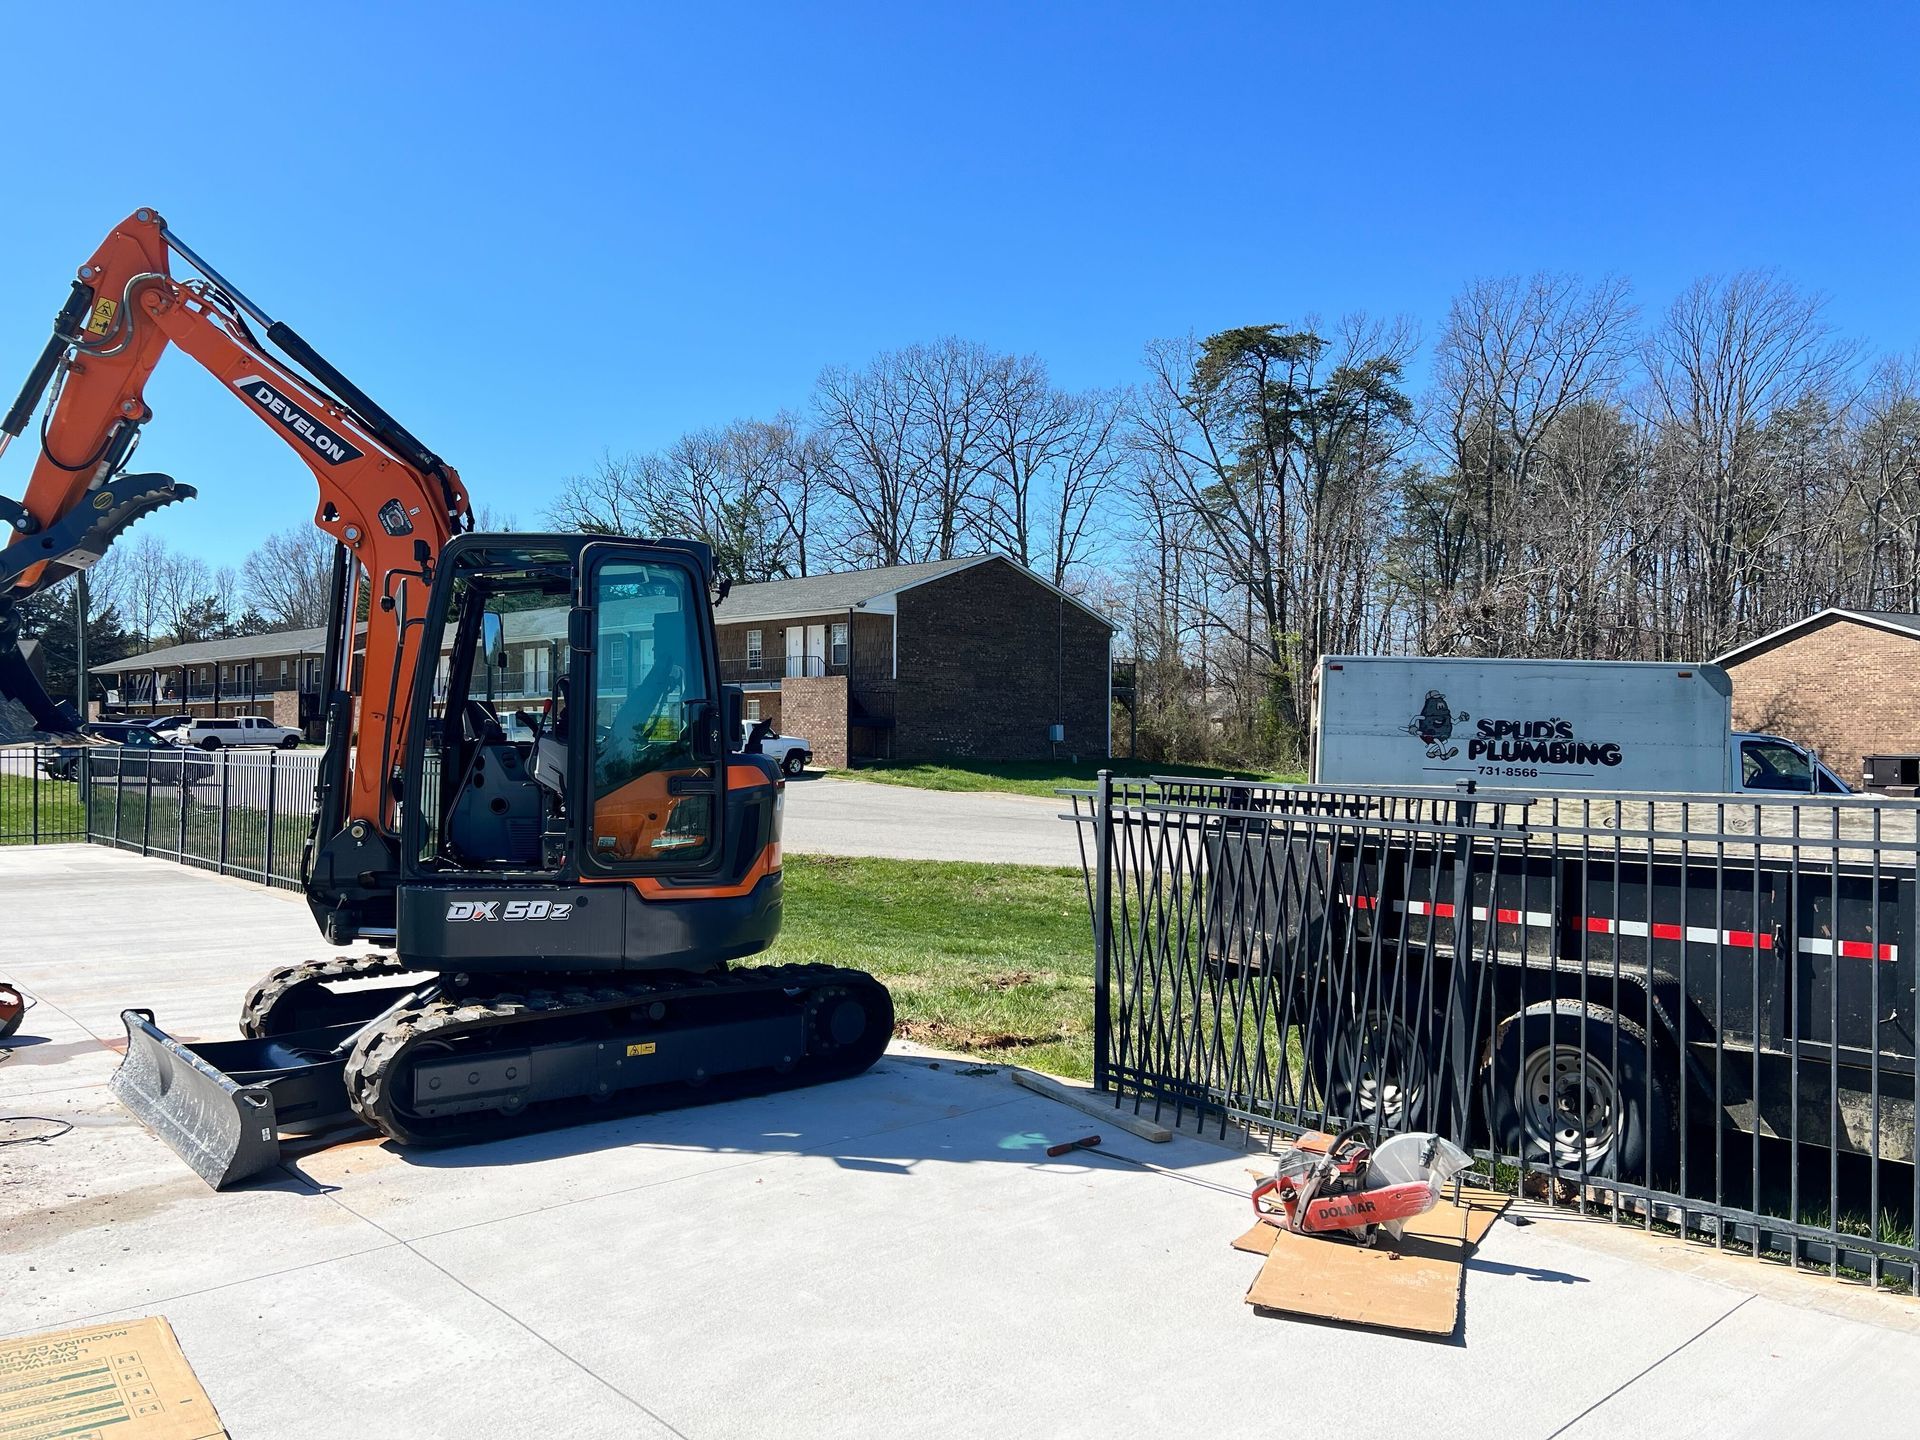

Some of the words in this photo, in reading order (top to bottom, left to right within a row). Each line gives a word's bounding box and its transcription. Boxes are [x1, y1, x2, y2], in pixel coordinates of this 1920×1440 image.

[254, 386, 346, 462] DEVELON
[1476, 717, 1574, 741] SPUD'S
[1468, 739, 1623, 767] PLUMBING
[1477, 766, 1539, 778] 731-8566
[446, 901, 500, 921] DX
[1319, 1201, 1376, 1219] DOLMAR
